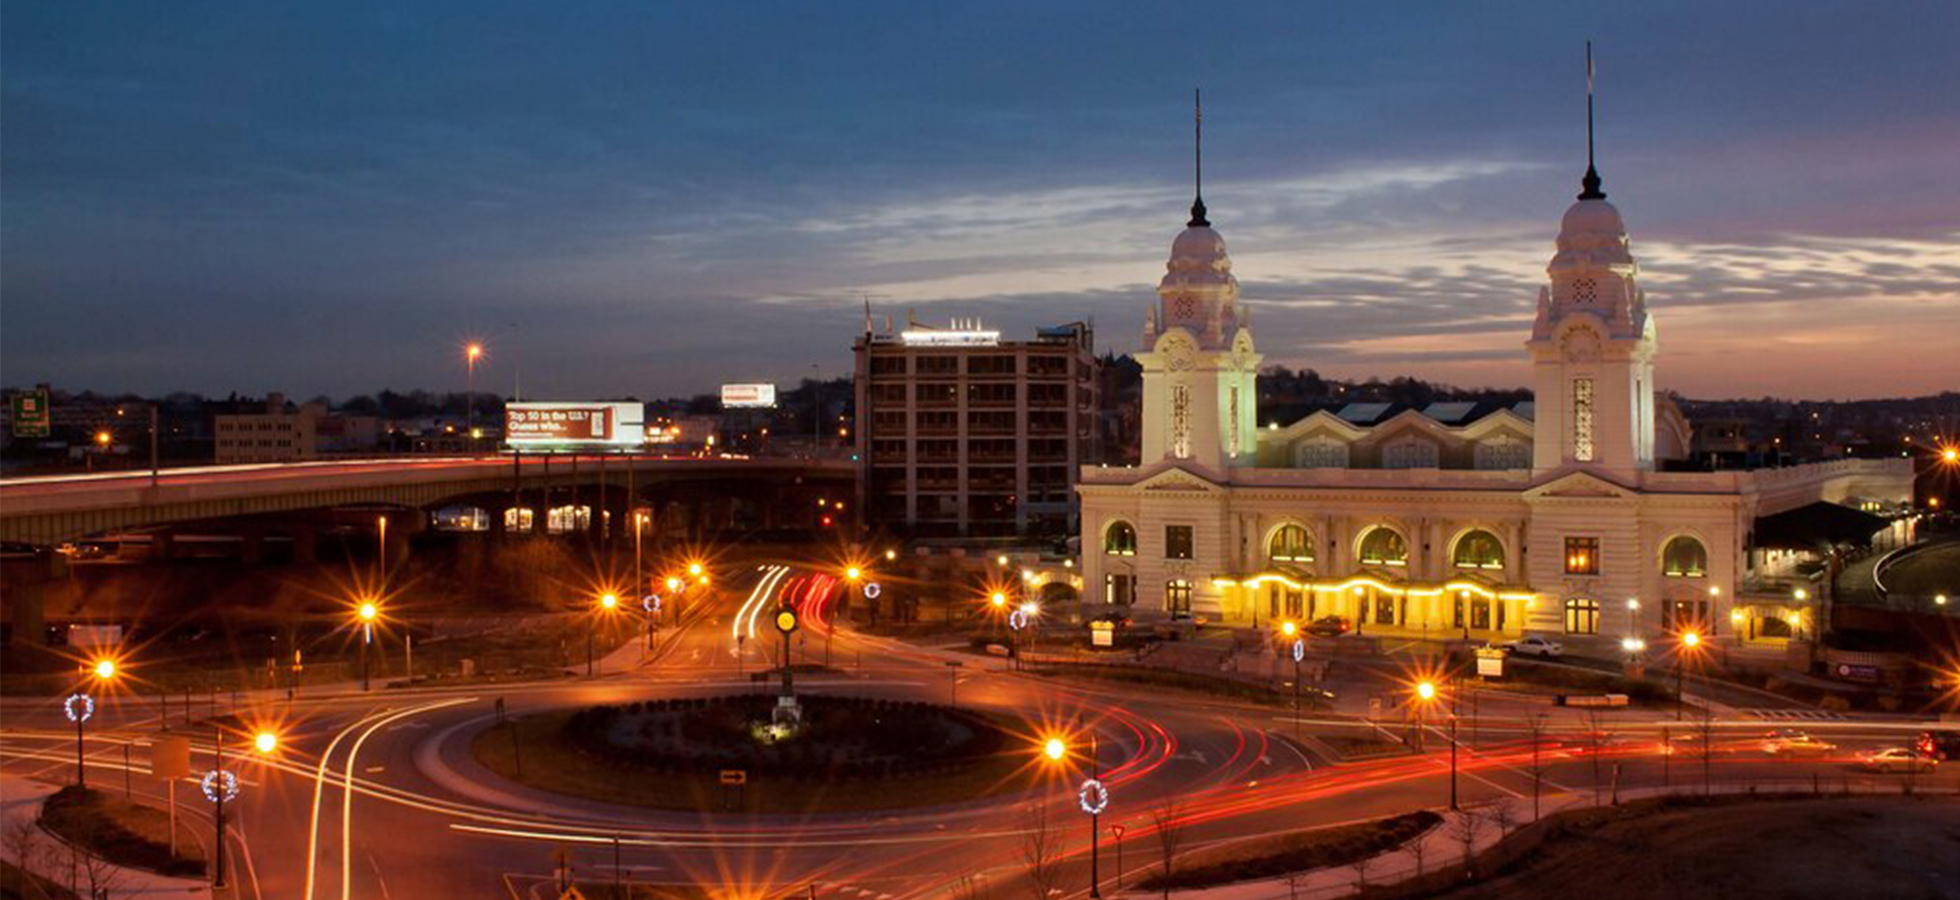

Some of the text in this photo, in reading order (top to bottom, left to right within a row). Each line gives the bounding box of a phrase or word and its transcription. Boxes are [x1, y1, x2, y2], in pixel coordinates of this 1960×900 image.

[509, 411, 526, 422] Top
[527, 411, 539, 421] 50
[541, 411, 550, 421] in
[552, 411, 567, 421] the
[509, 421, 538, 431] Guess
